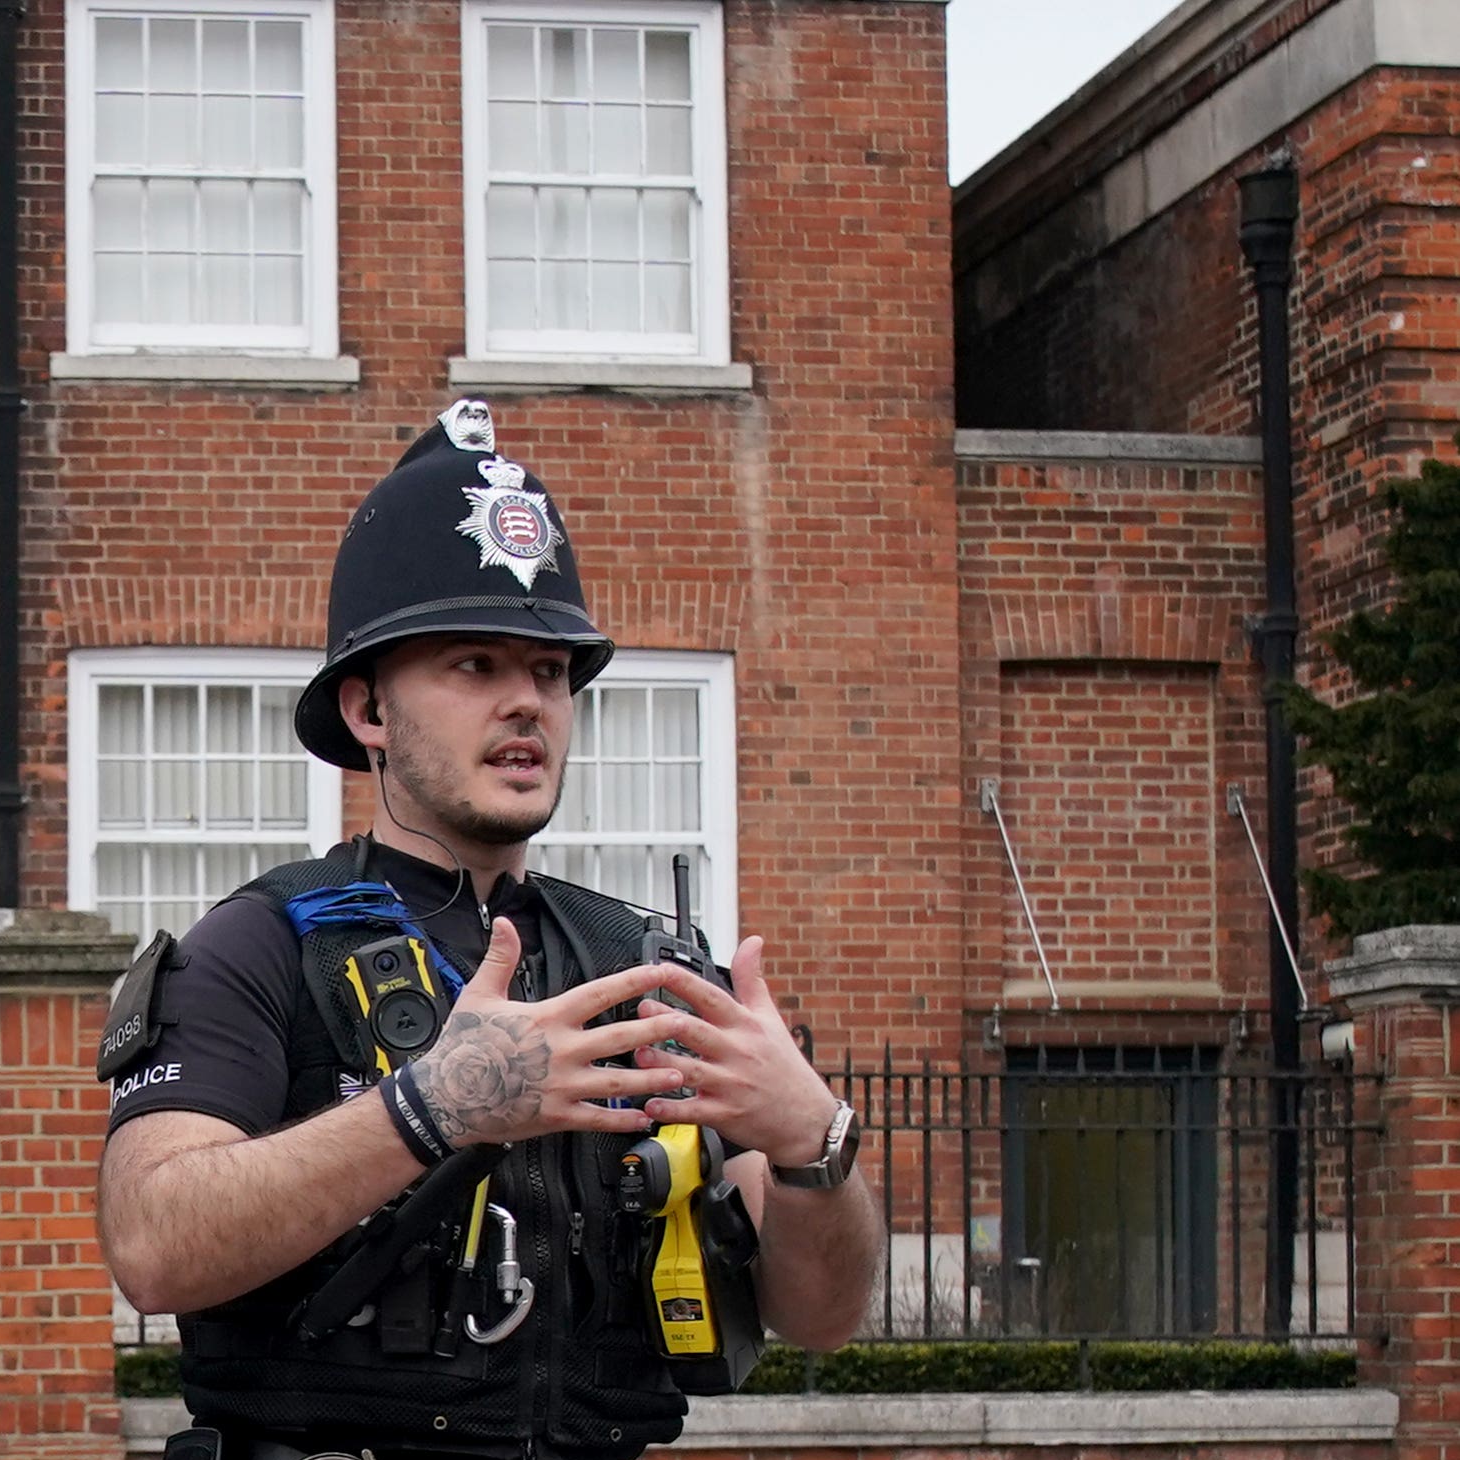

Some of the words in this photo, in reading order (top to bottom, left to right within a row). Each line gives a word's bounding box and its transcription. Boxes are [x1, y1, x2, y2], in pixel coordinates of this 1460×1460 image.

[496, 495, 531, 508] ESSEX
[503, 540, 542, 554] POLICE
[103, 1014, 141, 1058] 74098
[113, 1063, 181, 1110] POLICE
